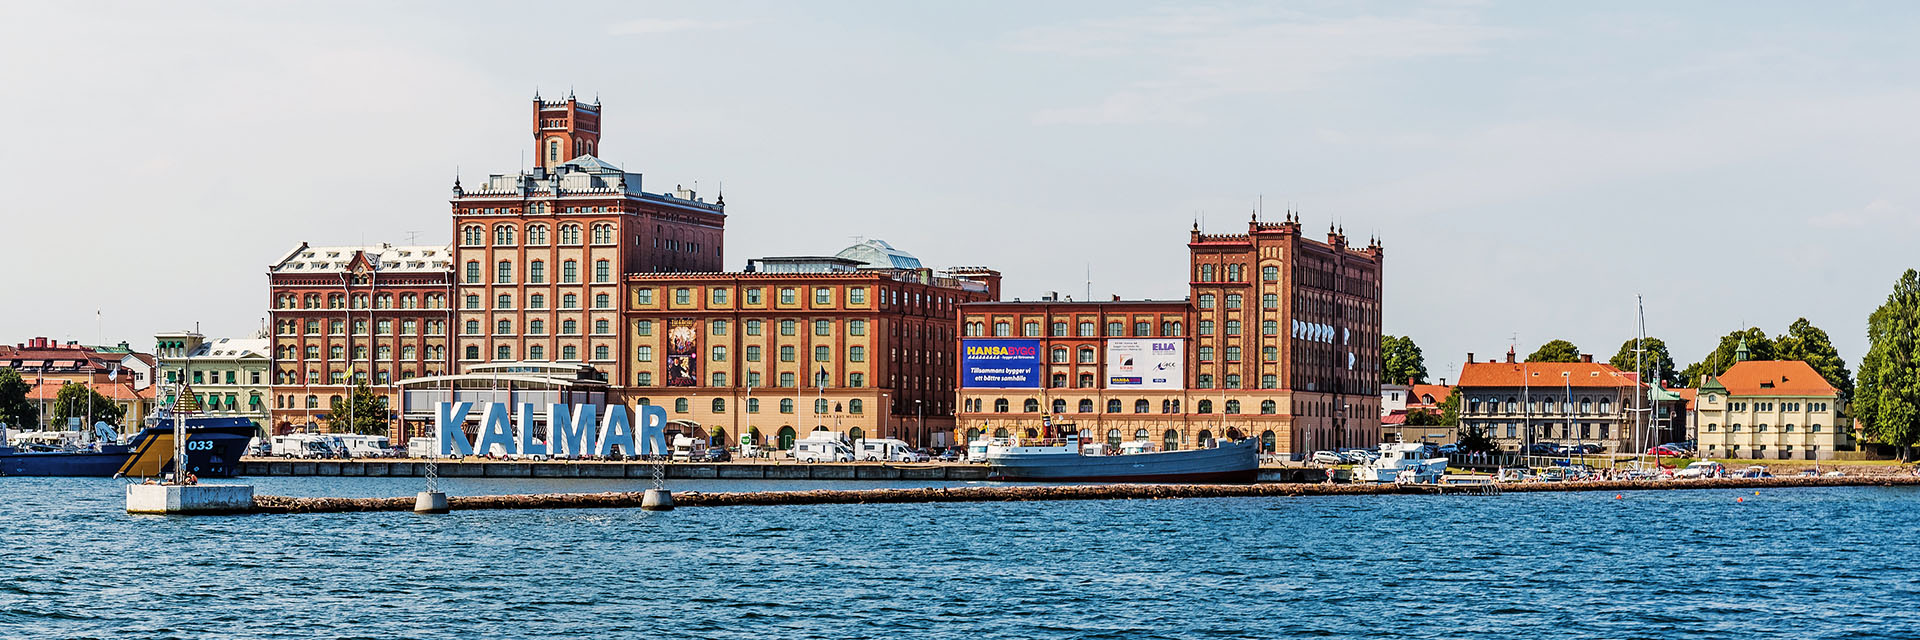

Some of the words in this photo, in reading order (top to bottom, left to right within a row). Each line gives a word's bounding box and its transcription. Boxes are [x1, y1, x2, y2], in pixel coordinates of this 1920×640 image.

[967, 346, 1036, 355] HANSABYGG
[1152, 343, 1175, 351] ELIA
[435, 401, 668, 456] KALMAR
[188, 440, 214, 451] 033
